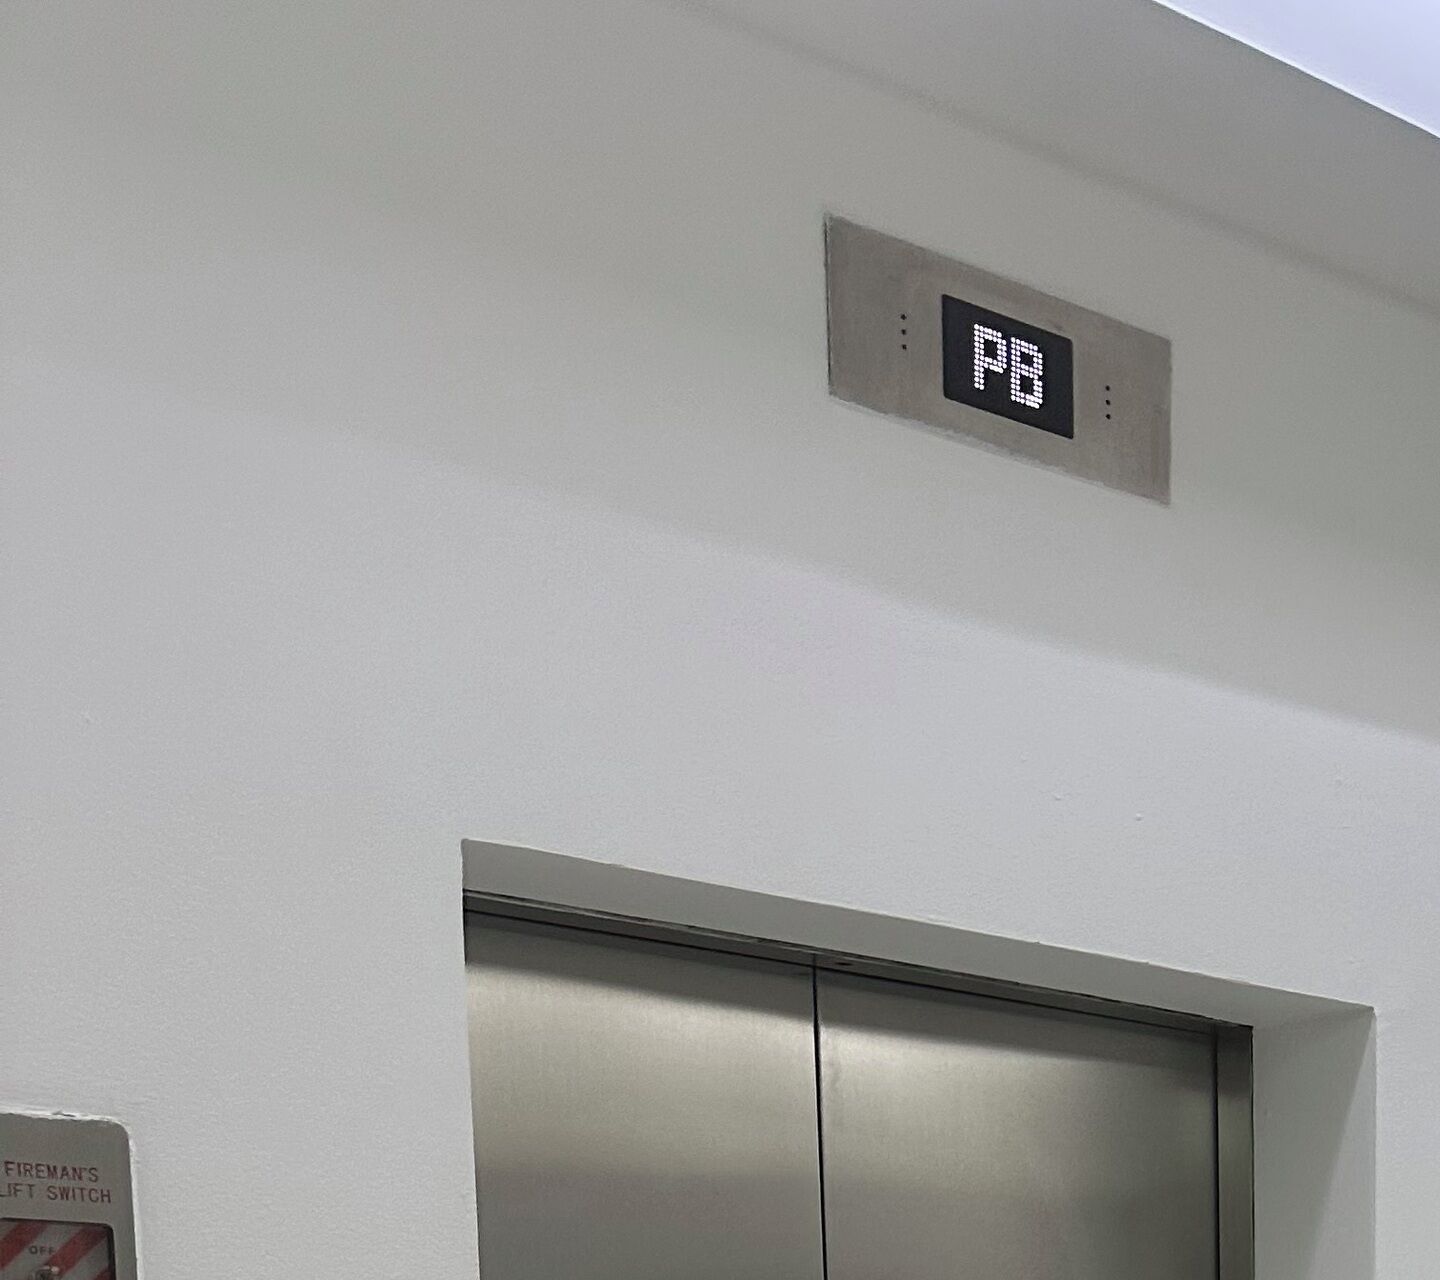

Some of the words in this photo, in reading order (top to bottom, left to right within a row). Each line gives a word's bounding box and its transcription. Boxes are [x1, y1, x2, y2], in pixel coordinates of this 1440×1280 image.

[972, 322, 1043, 410] PB
[4, 1160, 99, 1183] FIREMAN'S
[47, 1185, 112, 1204] SWITCH
[28, 1245, 54, 1256] OFF
